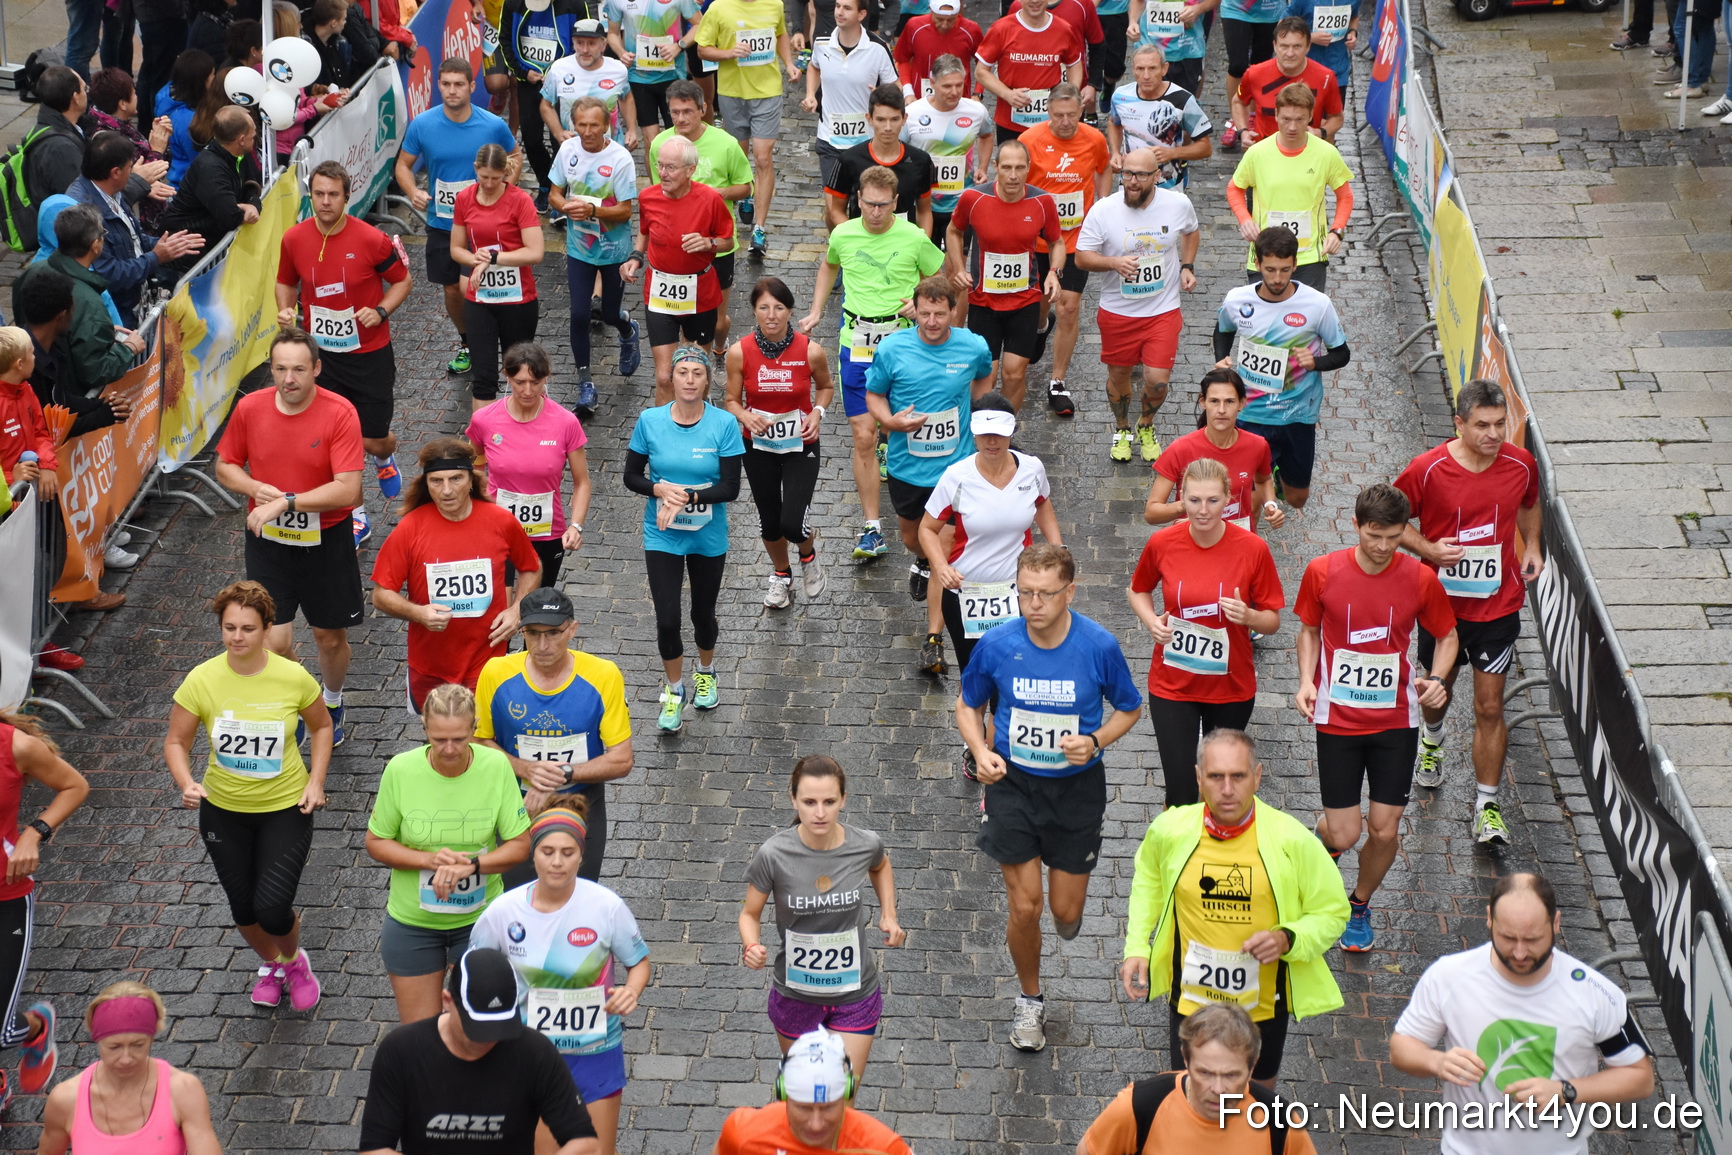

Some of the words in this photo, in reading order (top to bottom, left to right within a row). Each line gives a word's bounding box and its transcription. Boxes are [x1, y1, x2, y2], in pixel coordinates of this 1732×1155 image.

[1150, 10, 1180, 24] 2448
[1317, 15, 1348, 29] 2286
[523, 46, 551, 61] 2208
[1010, 53, 1053, 62] NEUMARKT
[833, 120, 865, 136] 3072
[993, 263, 1021, 278] 298
[487, 290, 508, 298] Sabine
[659, 283, 687, 299] 249
[1132, 286, 1154, 294] Markus
[665, 302, 680, 310] Willi
[315, 318, 354, 336] 2623
[323, 338, 348, 348] Markus
[1241, 350, 1282, 376] 2320
[913, 421, 955, 440] 2795
[925, 443, 945, 451] Claus
[276, 511, 308, 529] 129
[508, 505, 542, 522] 189
[674, 517, 692, 525] Julia
[279, 531, 301, 540] Bernd
[434, 573, 487, 598] 2503
[452, 601, 473, 611] Josef
[966, 596, 1012, 618] 2751
[1360, 631, 1377, 640] DEHN
[1172, 631, 1223, 659] 3078
[1338, 664, 1393, 688] 2126
[1013, 677, 1075, 694] HUBER
[1349, 691, 1377, 701] Tobias
[219, 733, 278, 757] 2217
[235, 759, 258, 770] Julia
[1030, 752, 1056, 763] Anton
[787, 889, 860, 909] LEHMEIER
[1202, 901, 1251, 912] HIRSCH
[793, 946, 854, 970] 2229
[803, 974, 842, 985] Theresa
[1198, 964, 1246, 990] 209
[1206, 990, 1239, 1003] Robert
[537, 1005, 600, 1031] 2407
[555, 1037, 581, 1049] Katja
